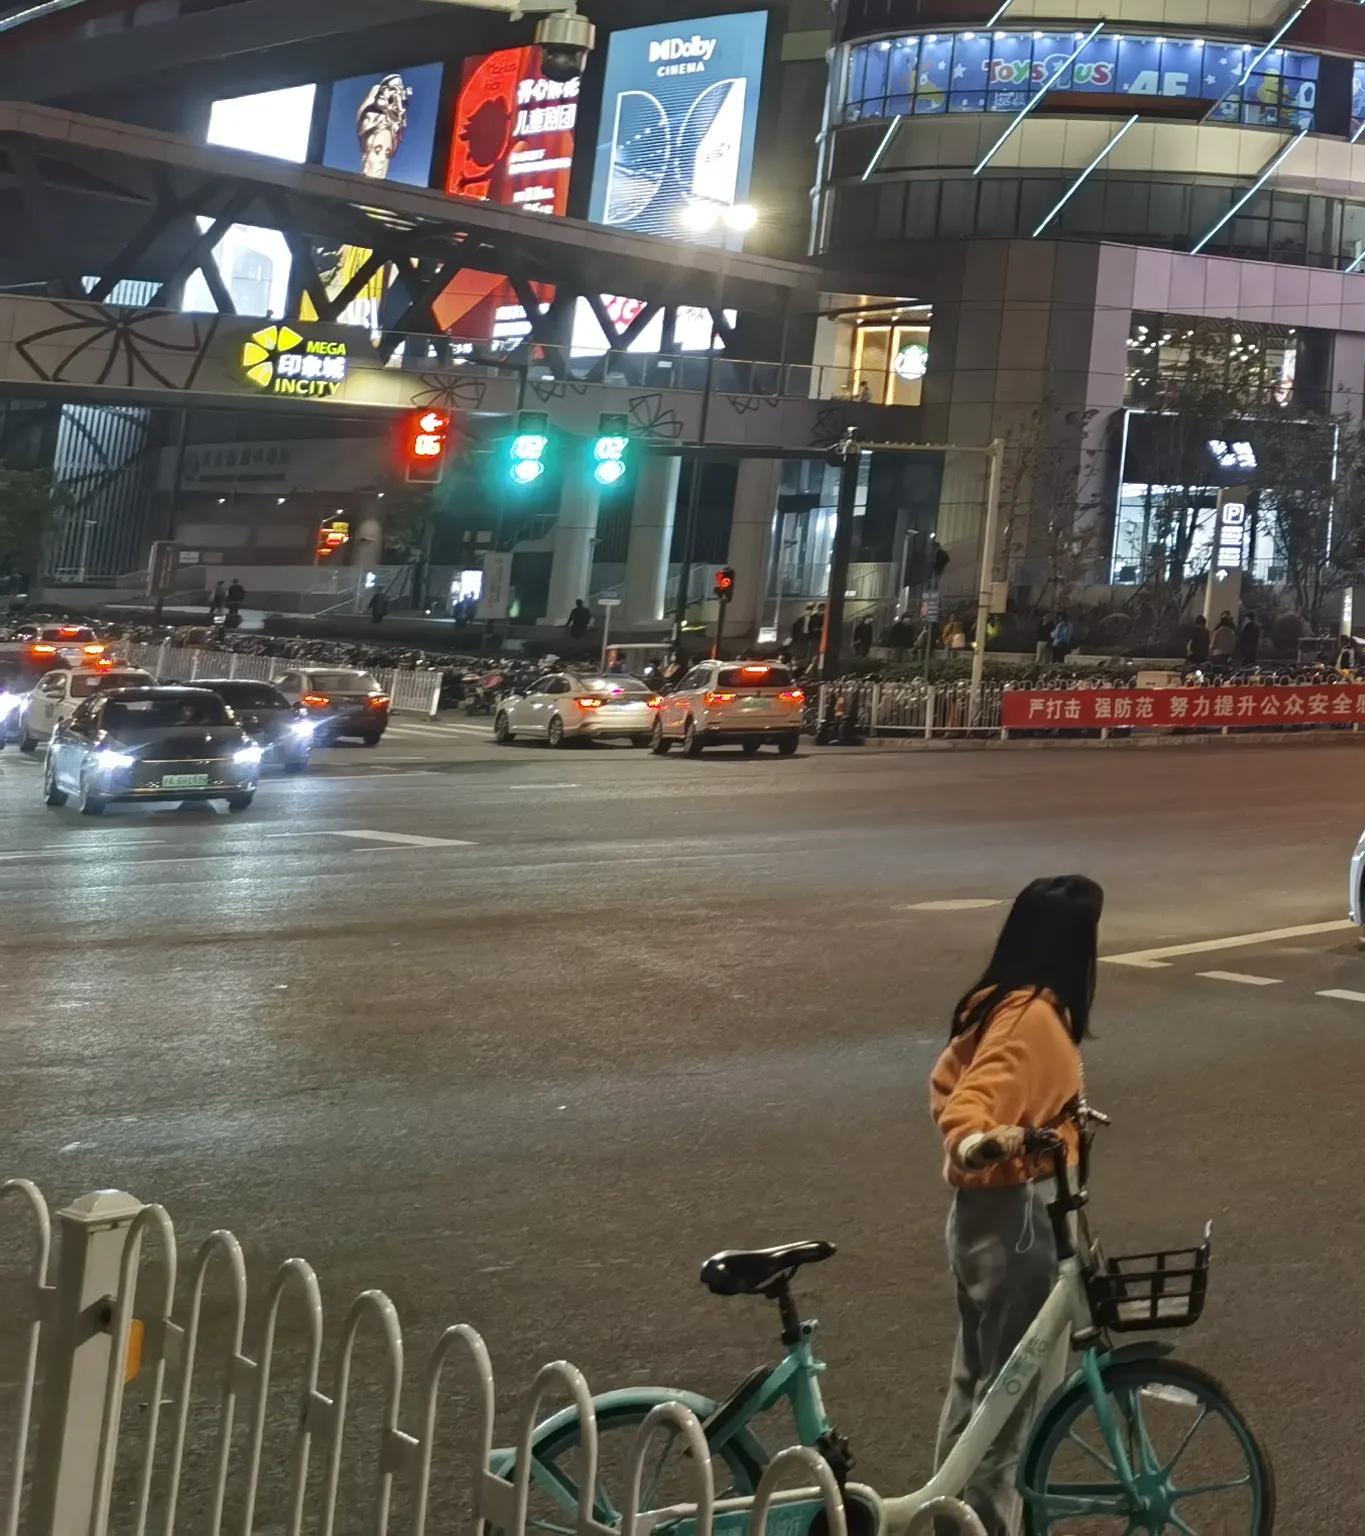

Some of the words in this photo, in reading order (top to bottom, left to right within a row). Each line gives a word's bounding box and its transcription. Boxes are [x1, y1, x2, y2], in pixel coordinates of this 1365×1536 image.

[656, 61, 705, 77] CINEMA
[306, 340, 347, 356] MEGA
[274, 378, 341, 395] INCITY
[1028, 697, 1081, 720] 严打击
[1094, 696, 1154, 719] 强防范
